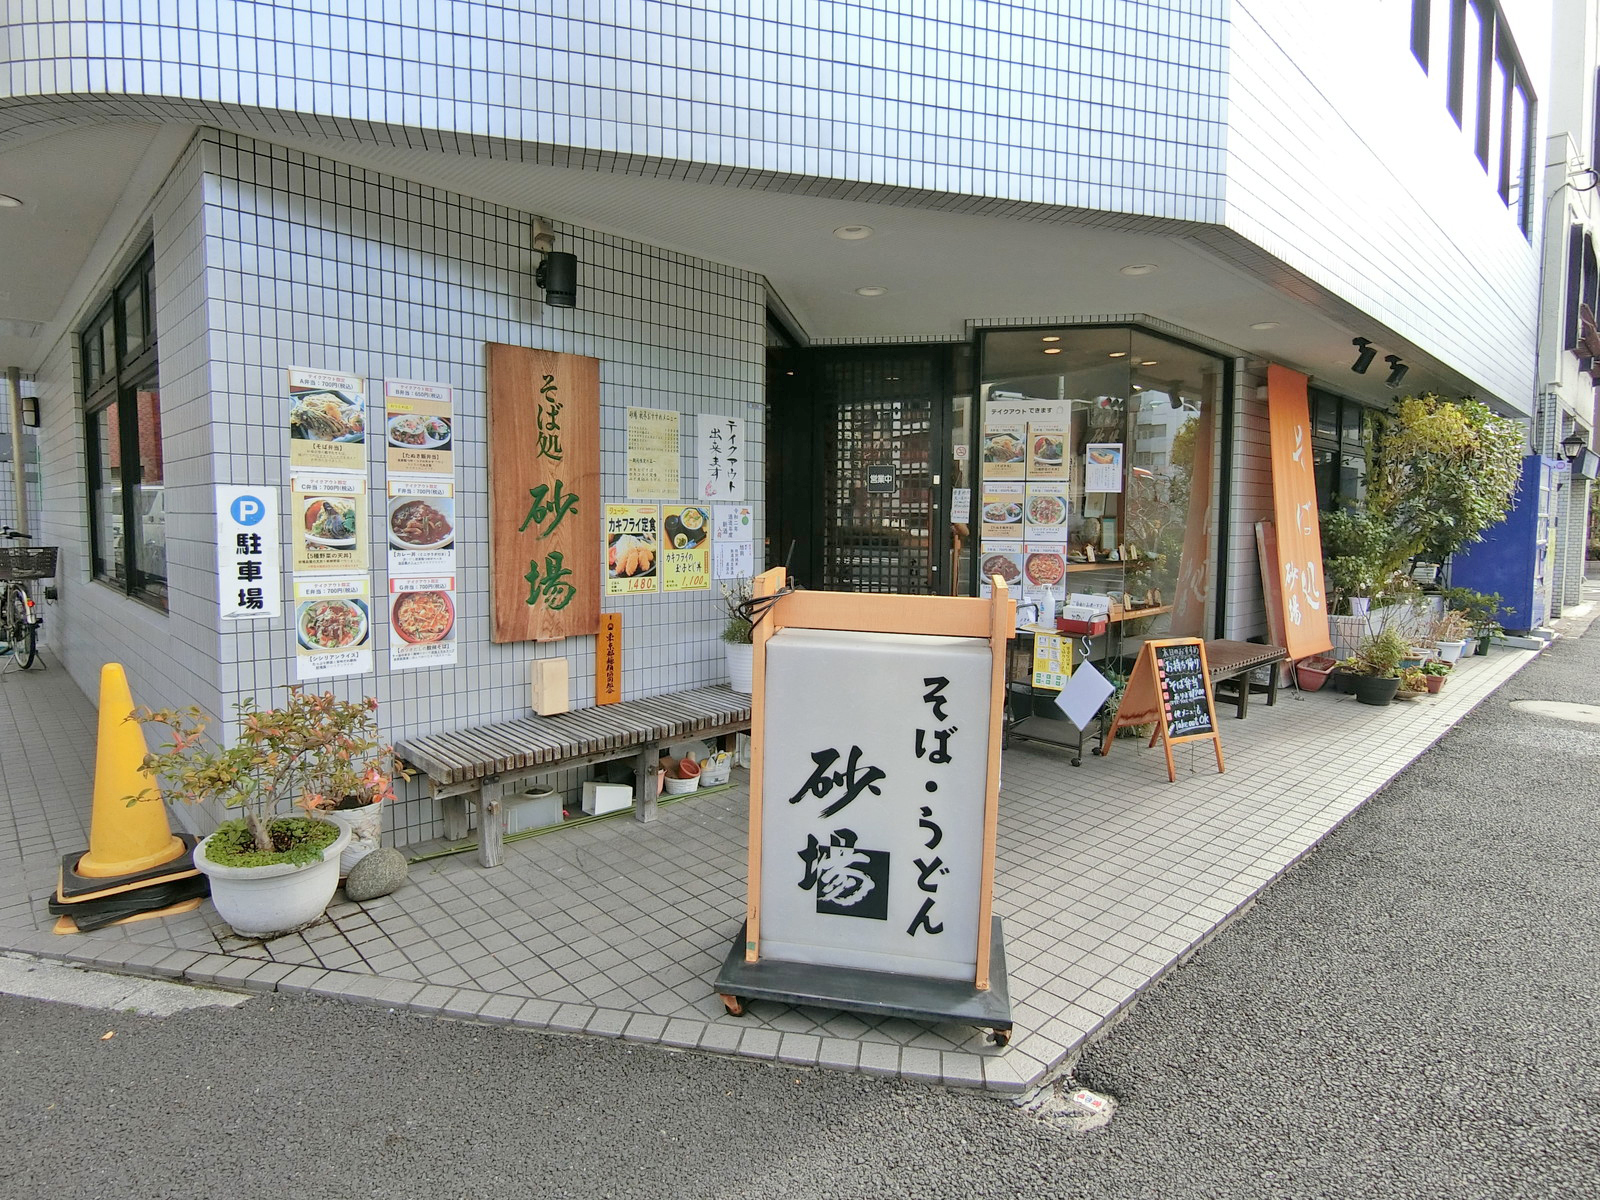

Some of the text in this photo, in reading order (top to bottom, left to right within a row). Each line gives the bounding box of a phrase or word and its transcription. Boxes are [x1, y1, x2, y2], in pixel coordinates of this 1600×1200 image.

[536, 374, 564, 462] そば処
[708, 427, 722, 481] 出来ます
[726, 420, 738, 493] テイクアウト
[240, 500, 259, 522] P
[518, 479, 580, 611] 砂場
[608, 517, 657, 533] カキフライ定食
[1293, 424, 1320, 610] そば処
[236, 532, 264, 610] 駐車場
[1284, 560, 1302, 627] 砂場
[788, 745, 890, 908] 砂場
[906, 676, 959, 937] そば・うどん
